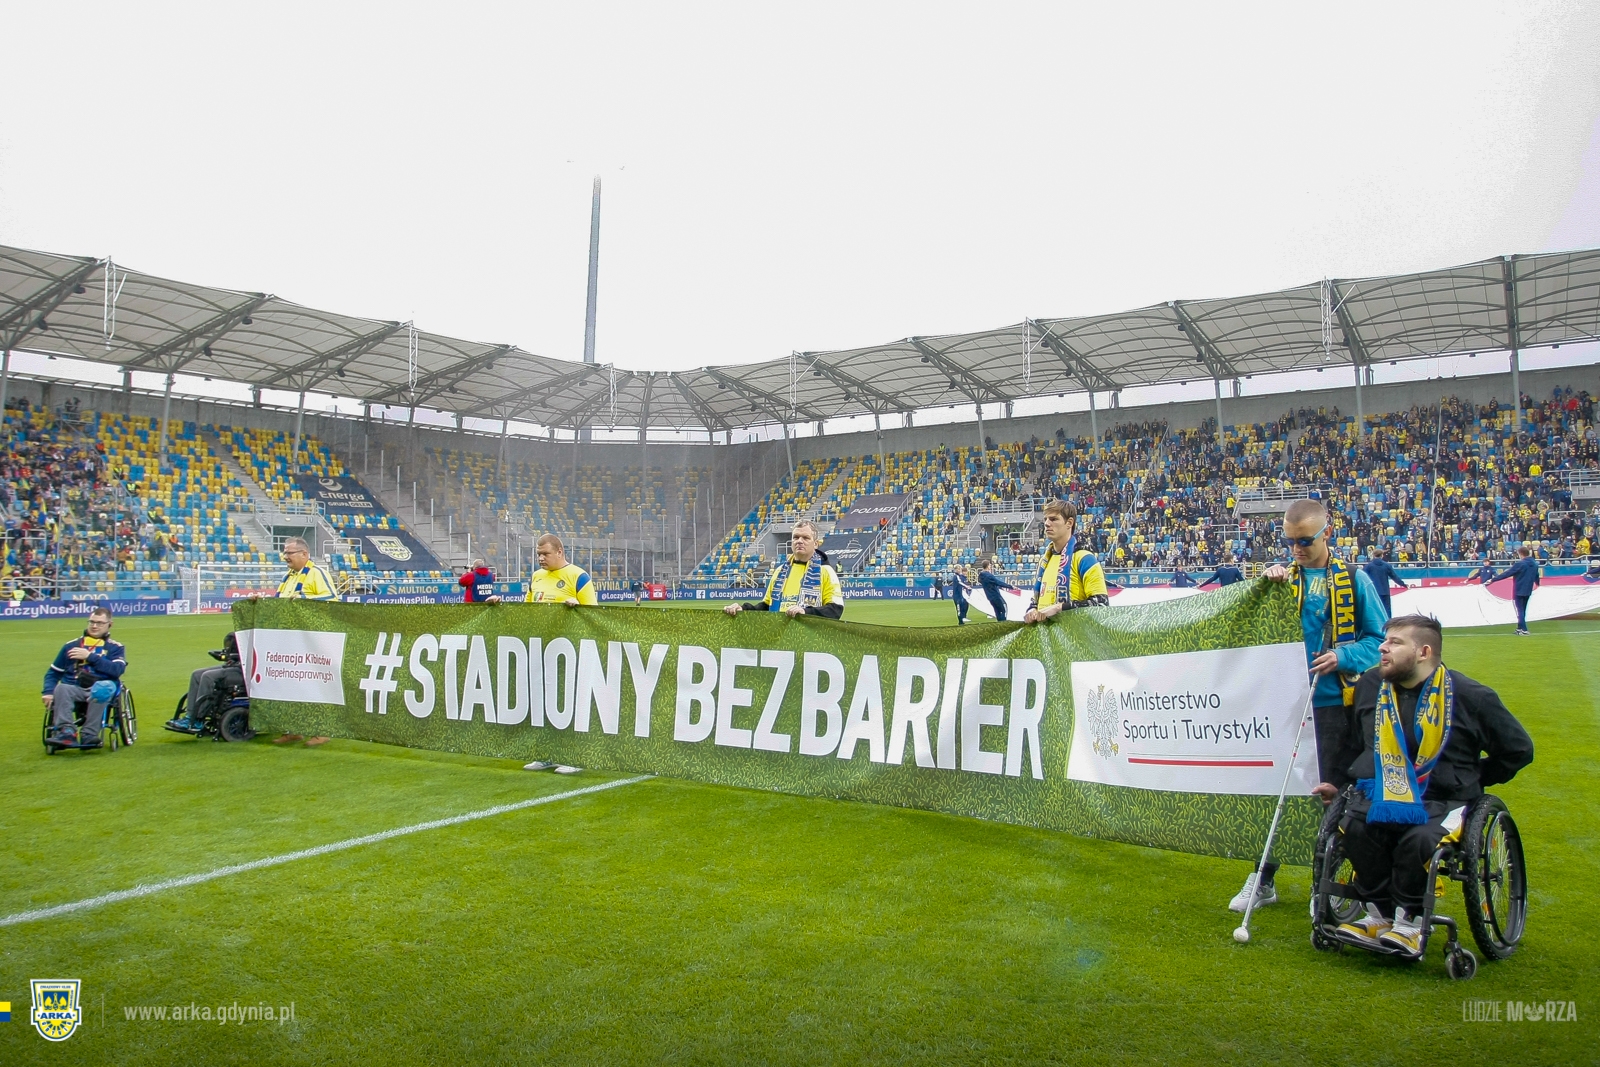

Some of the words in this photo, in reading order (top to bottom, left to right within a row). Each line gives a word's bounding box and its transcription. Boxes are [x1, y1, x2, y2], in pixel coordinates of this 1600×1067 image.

[398, 586, 438, 594] MULTILOG
[110, 602, 148, 615] Wejdź
[266, 651, 303, 666] Federacja
[305, 653, 331, 666] Kibiców
[265, 667, 334, 683] Niepełnosprawnych
[358, 631, 669, 738] #STADIONY
[674, 645, 795, 753] BEZ
[799, 651, 1047, 780] BARIER
[1120, 690, 1221, 711] Ministerstwo
[1123, 719, 1169, 742] Sportu
[1173, 719, 1177, 739] i
[1181, 717, 1271, 744] Turystyki
